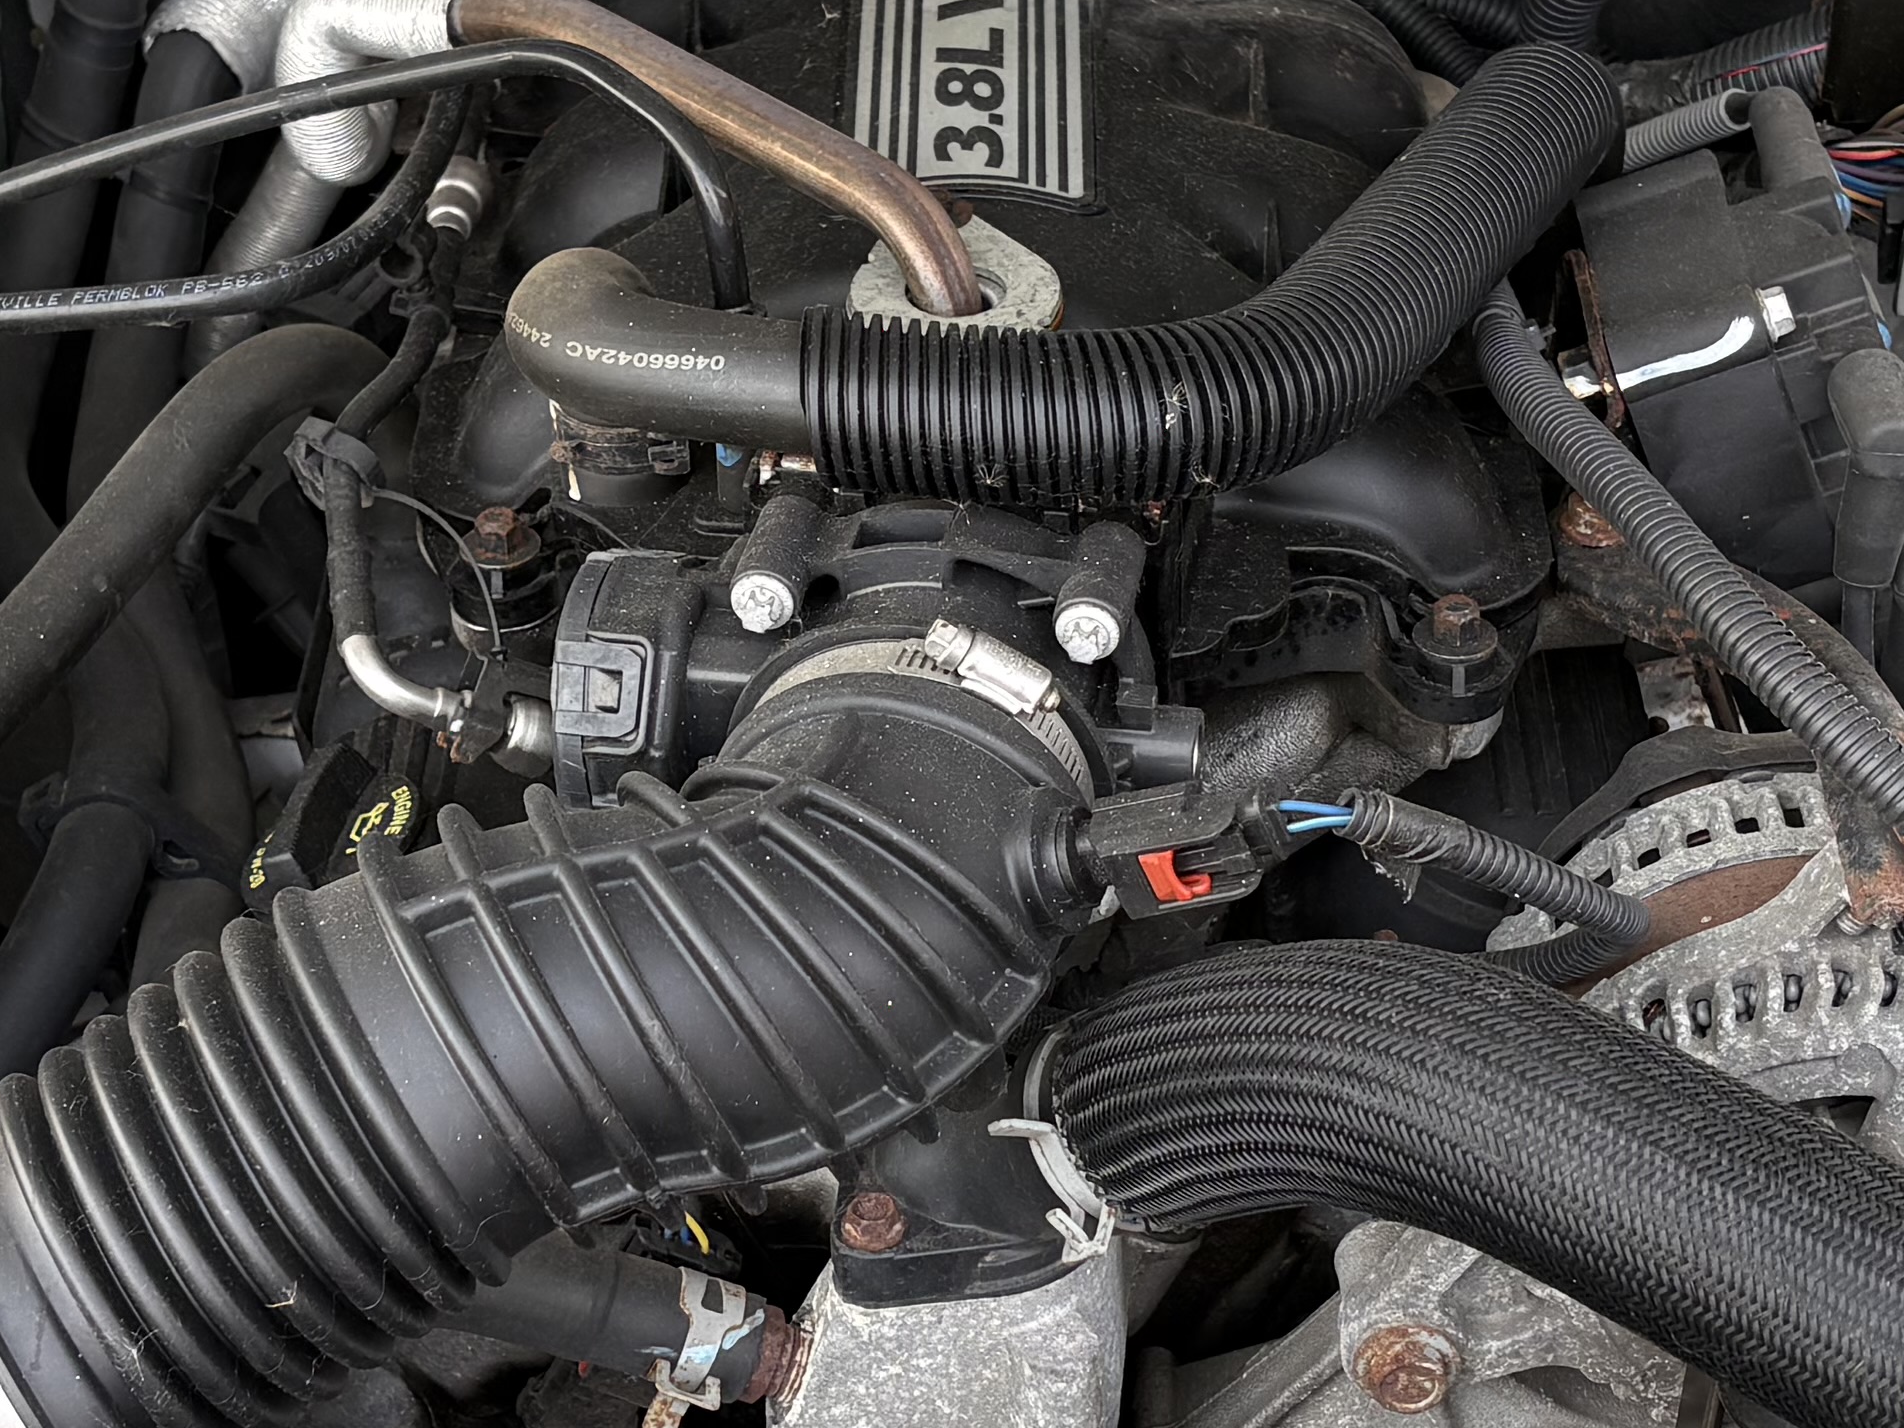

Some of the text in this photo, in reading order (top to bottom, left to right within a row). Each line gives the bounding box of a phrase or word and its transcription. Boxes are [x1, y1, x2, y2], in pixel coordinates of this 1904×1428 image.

[933, 26, 1005, 170] 3.8L
[70, 282, 168, 307] PERMBLOK
[564, 340, 726, 372] 04666042AC
[383, 784, 413, 836] ENGINE
